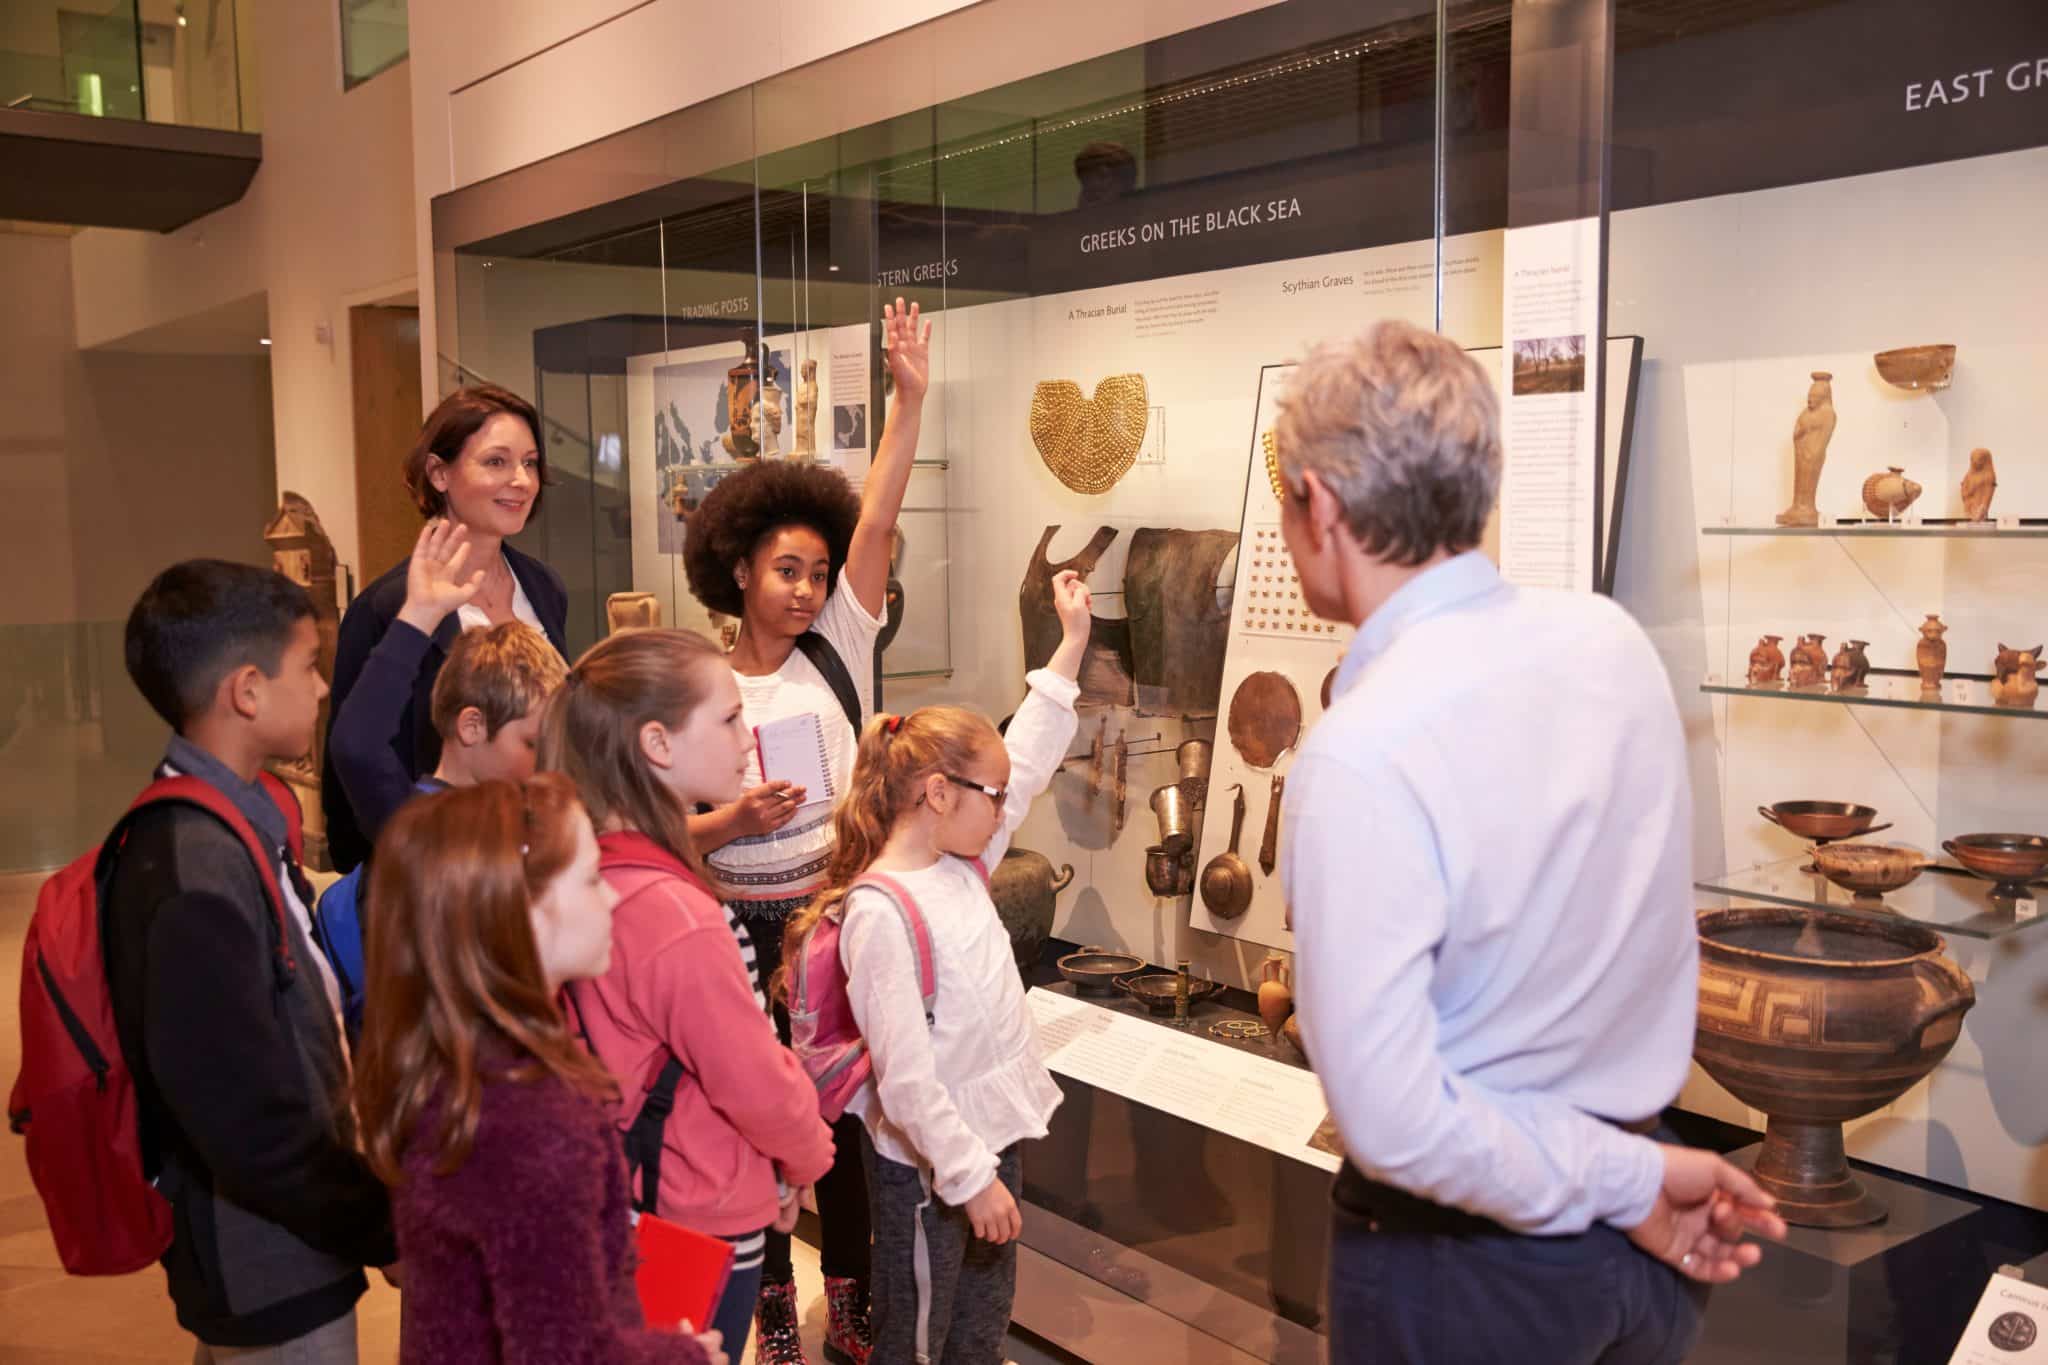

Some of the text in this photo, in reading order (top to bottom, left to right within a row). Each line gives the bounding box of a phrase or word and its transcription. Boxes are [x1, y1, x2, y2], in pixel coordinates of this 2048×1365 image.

[1906, 69, 1993, 111] EAST
[1080, 198, 1301, 253] GREEKS ON THE BLACK SEA
[913, 258, 958, 282] GREEKS
[1281, 275, 1354, 295] Scythian Graves
[682, 297, 749, 320] TRADING POSTS
[1068, 310, 1075, 320] A
